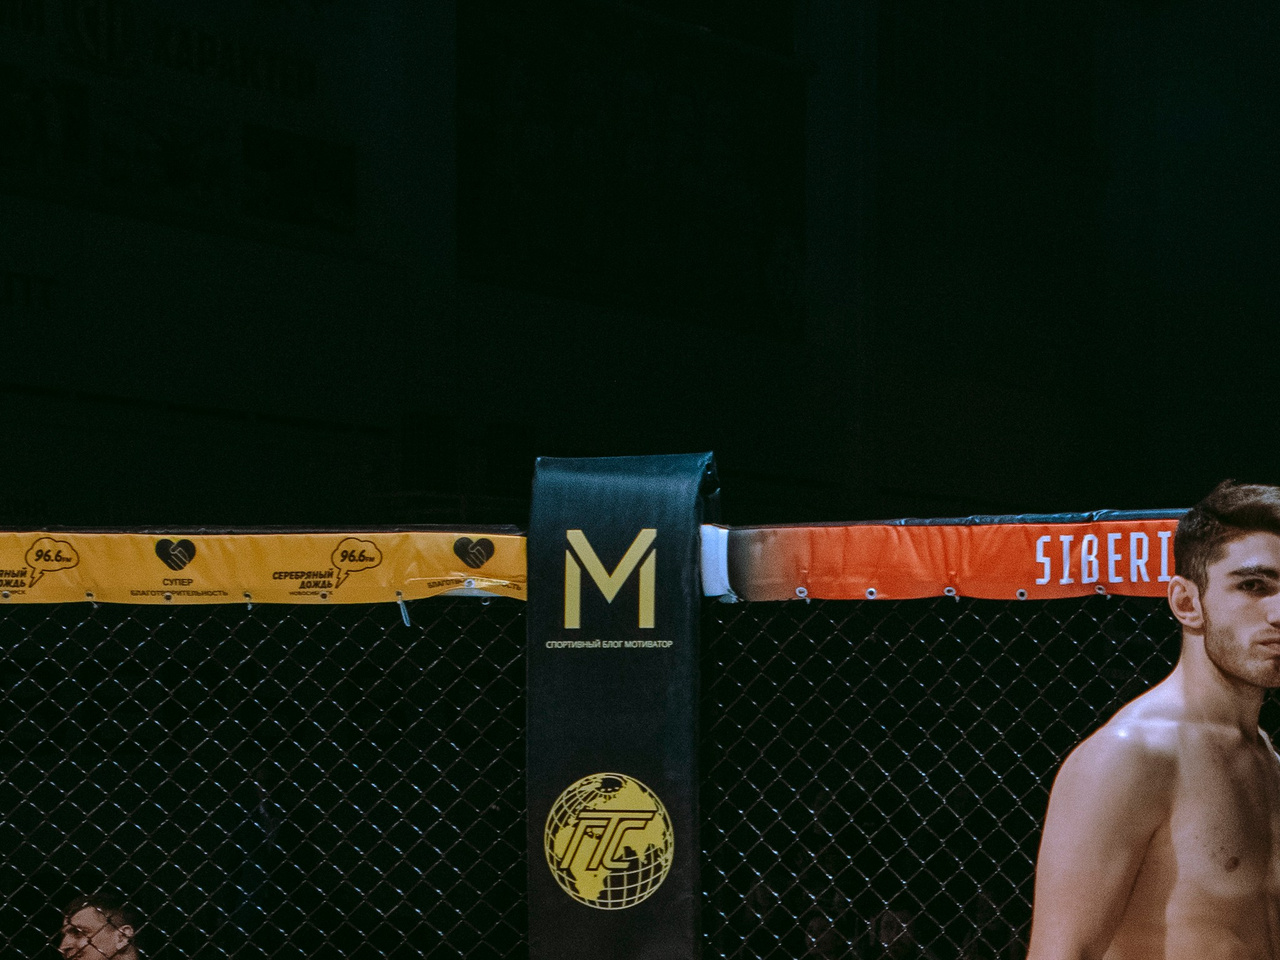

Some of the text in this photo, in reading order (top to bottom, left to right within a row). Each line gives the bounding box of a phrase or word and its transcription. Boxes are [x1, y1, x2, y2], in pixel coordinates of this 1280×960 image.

[1035, 530, 1172, 585] SIBERI
[272, 568, 334, 580] СЕРЕБРЯНЫЙ
[163, 578, 193, 586] СУПЕР
[299, 580, 333, 589] ДОЖДЬ
[546, 639, 673, 648] СПОРТИВНЫЙ БЛОГ МОТИВАТОР
